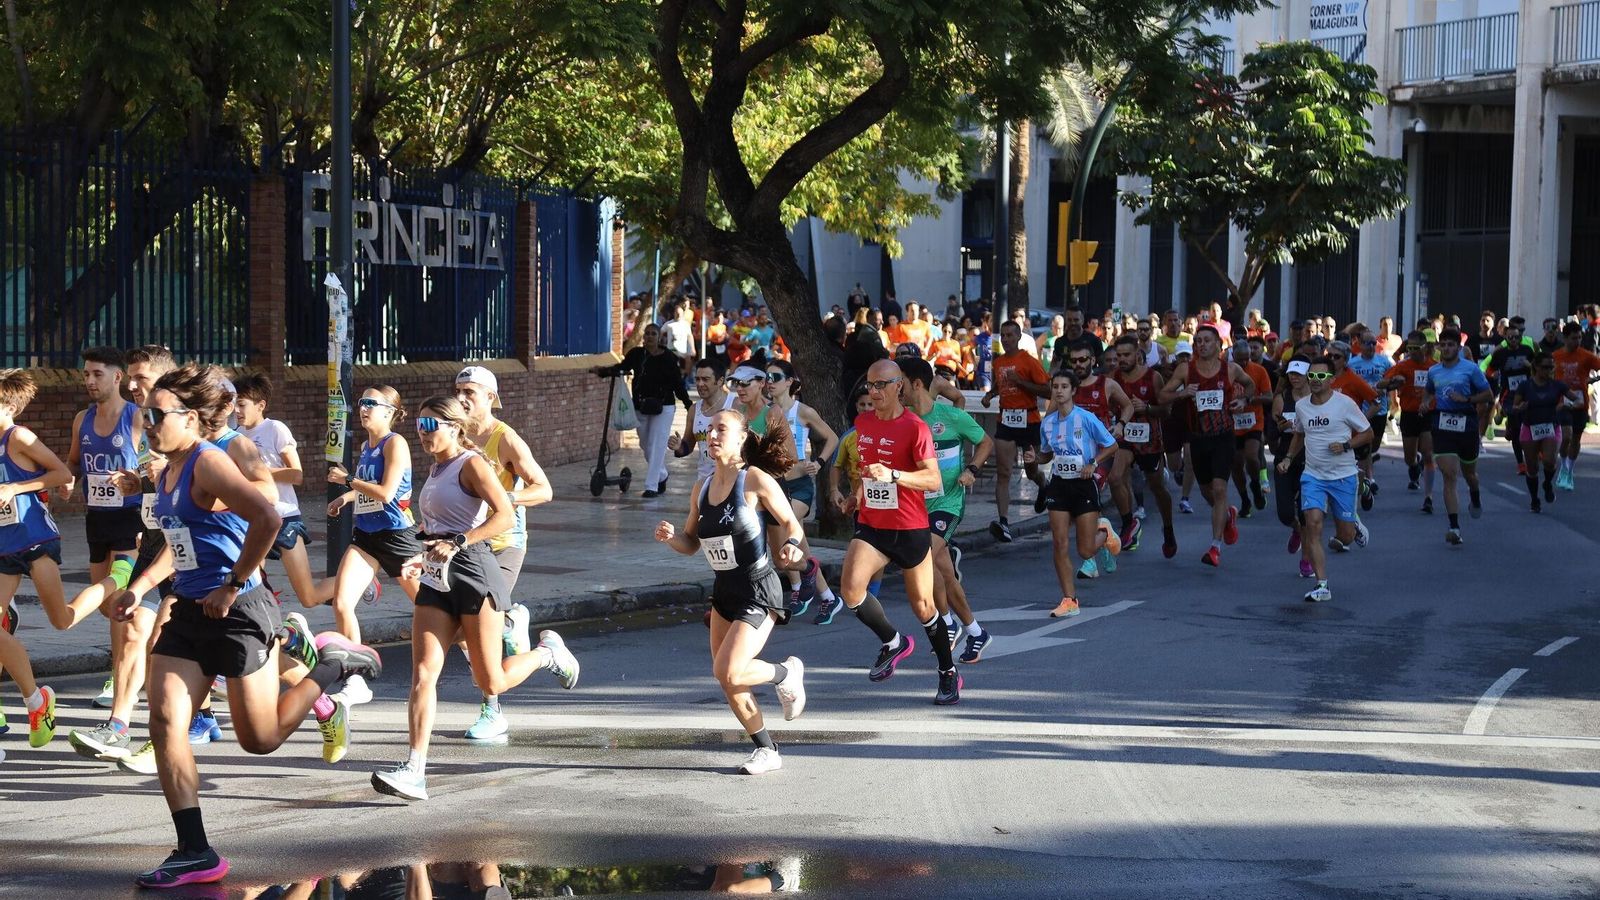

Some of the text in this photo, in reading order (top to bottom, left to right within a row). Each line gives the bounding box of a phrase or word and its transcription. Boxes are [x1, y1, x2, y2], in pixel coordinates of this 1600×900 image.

[1345, 2, 1359, 14] VIP
[1200, 396, 1219, 406] 755
[1005, 415, 1023, 423] 150
[1308, 416, 1330, 427] nike
[1446, 418, 1458, 426] 40
[1126, 428, 1144, 437] 787
[84, 452, 123, 473] RCM
[1057, 463, 1077, 472] 938
[91, 486, 116, 497] 736
[867, 488, 890, 500] 882
[708, 548, 729, 561] 110
